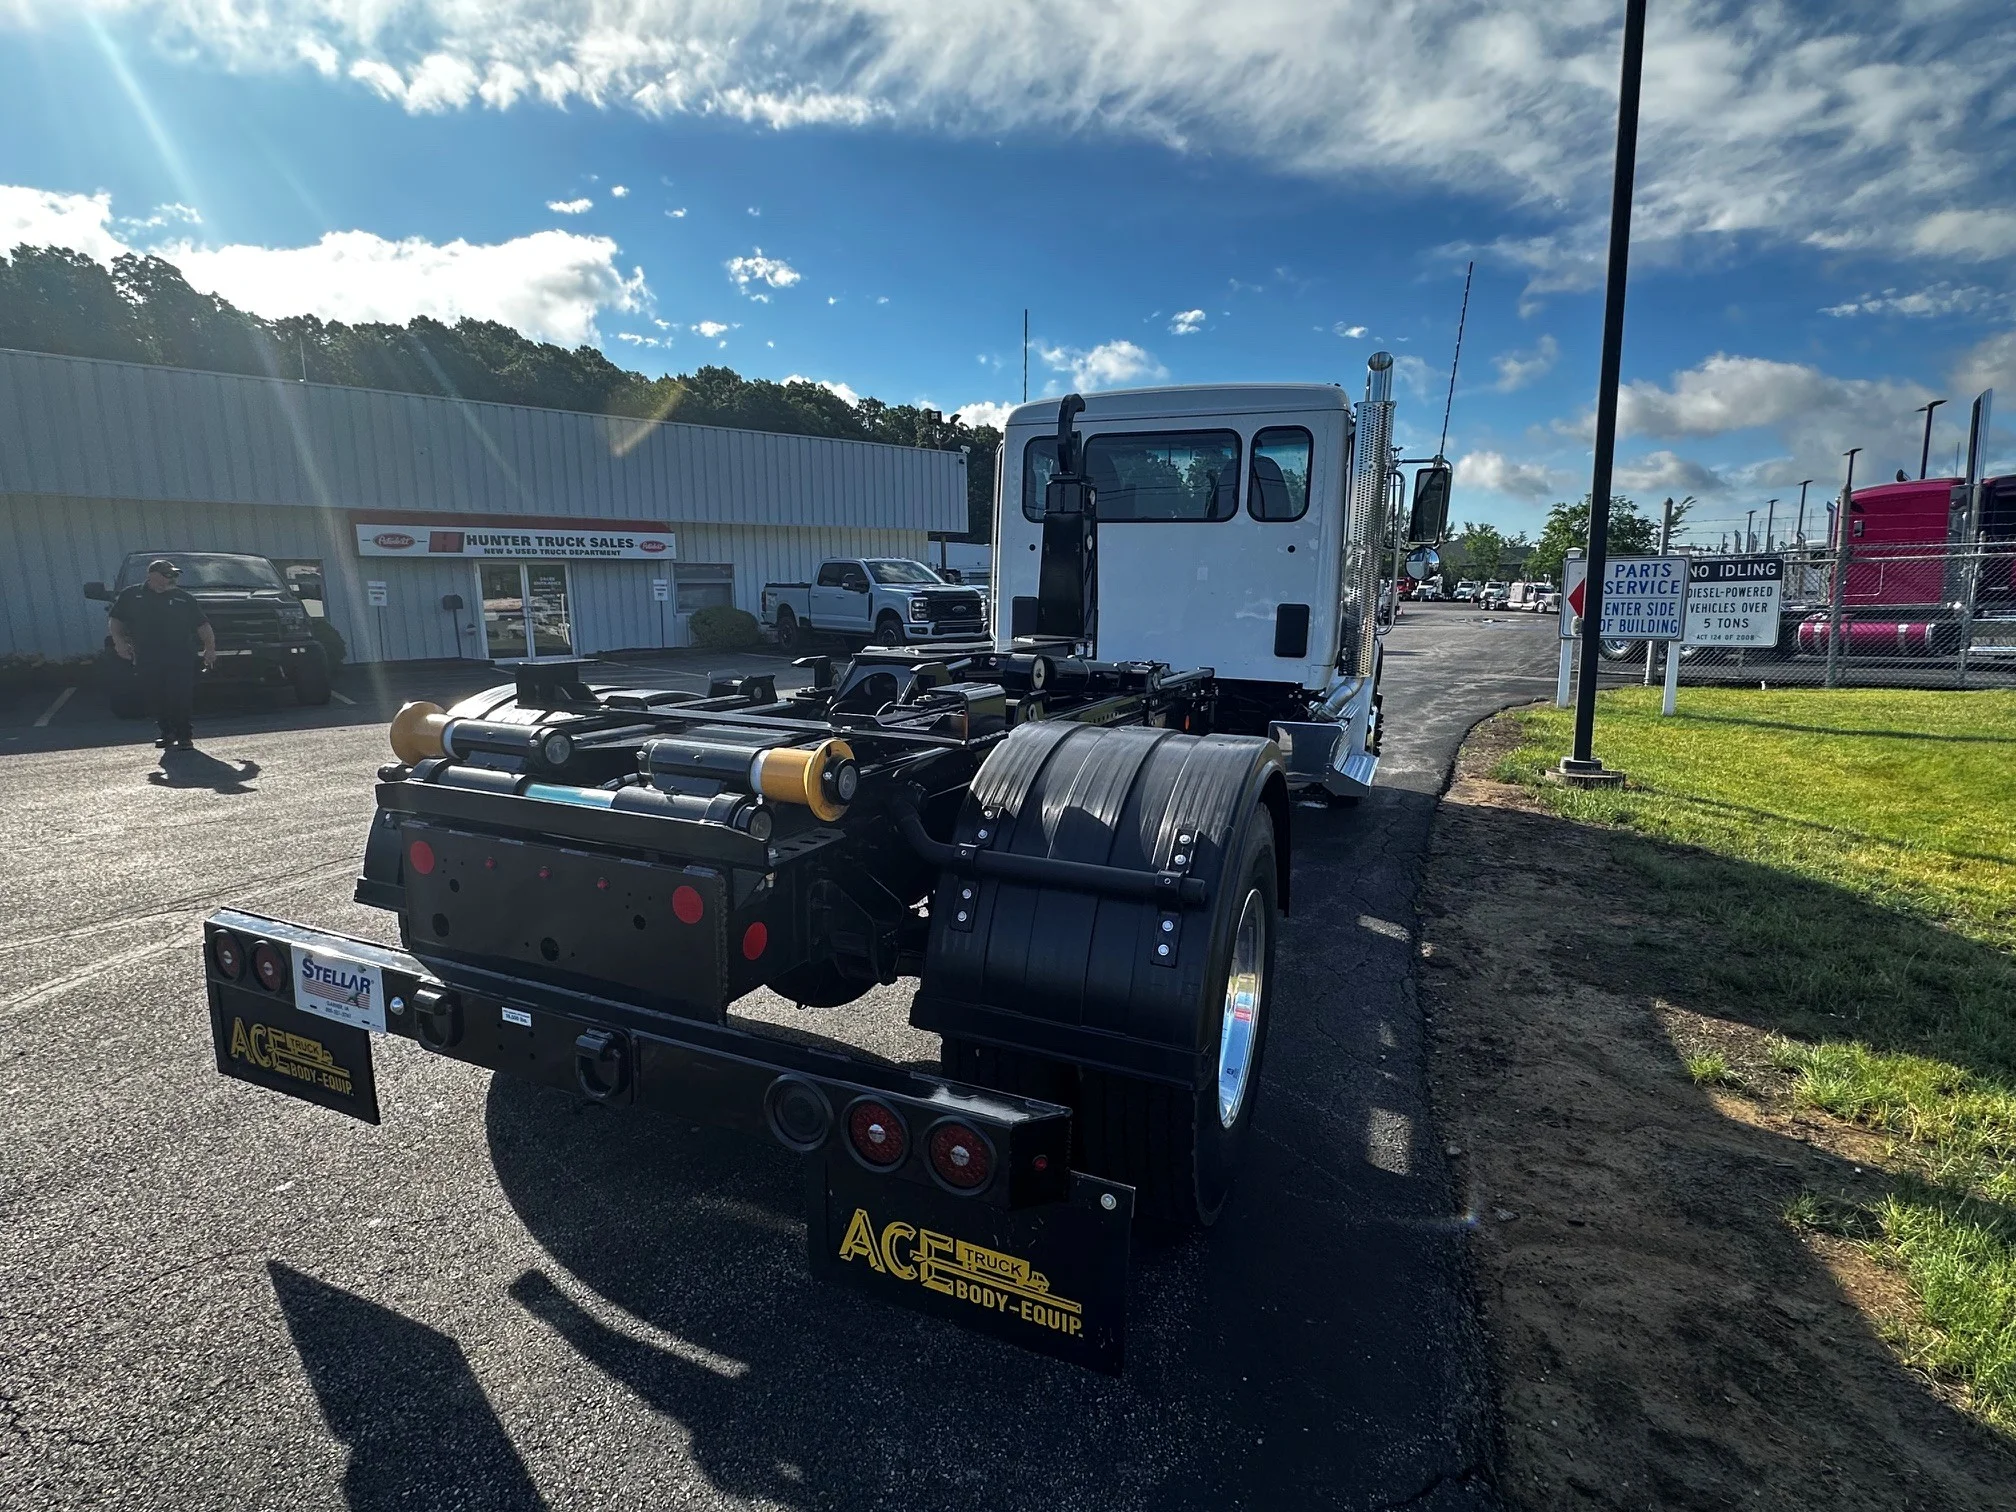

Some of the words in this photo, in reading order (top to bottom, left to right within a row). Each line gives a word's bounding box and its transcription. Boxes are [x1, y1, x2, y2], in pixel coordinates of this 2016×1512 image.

[466, 534, 531, 546] HUNTER
[535, 536, 586, 548] TRUCK
[589, 537, 635, 548] SALES
[1615, 563, 1672, 578] PARTS
[1720, 562, 1776, 577] IDLING
[1604, 580, 1681, 595] SERVICE
[1687, 586, 1773, 599] DIESEL-POWERED
[1604, 602, 1641, 616] ENTER
[1647, 602, 1676, 616] SIDE
[1689, 602, 1736, 614] VEHICLES
[1741, 602, 1768, 613] OVER
[1600, 618, 1614, 633] OF
[1619, 618, 1678, 634] BUILDING
[1703, 618, 1711, 629] 5
[1718, 618, 1749, 629] TONS
[302, 957, 372, 995] STELLAR
[231, 1016, 288, 1075] ACE
[291, 1038, 320, 1055] TRUCK
[289, 1062, 355, 1096] BODY-EQUIP.
[839, 1208, 954, 1296] ACE
[964, 1248, 1023, 1278] TRUCK
[956, 1279, 1084, 1338] BODY-EQUIP.
